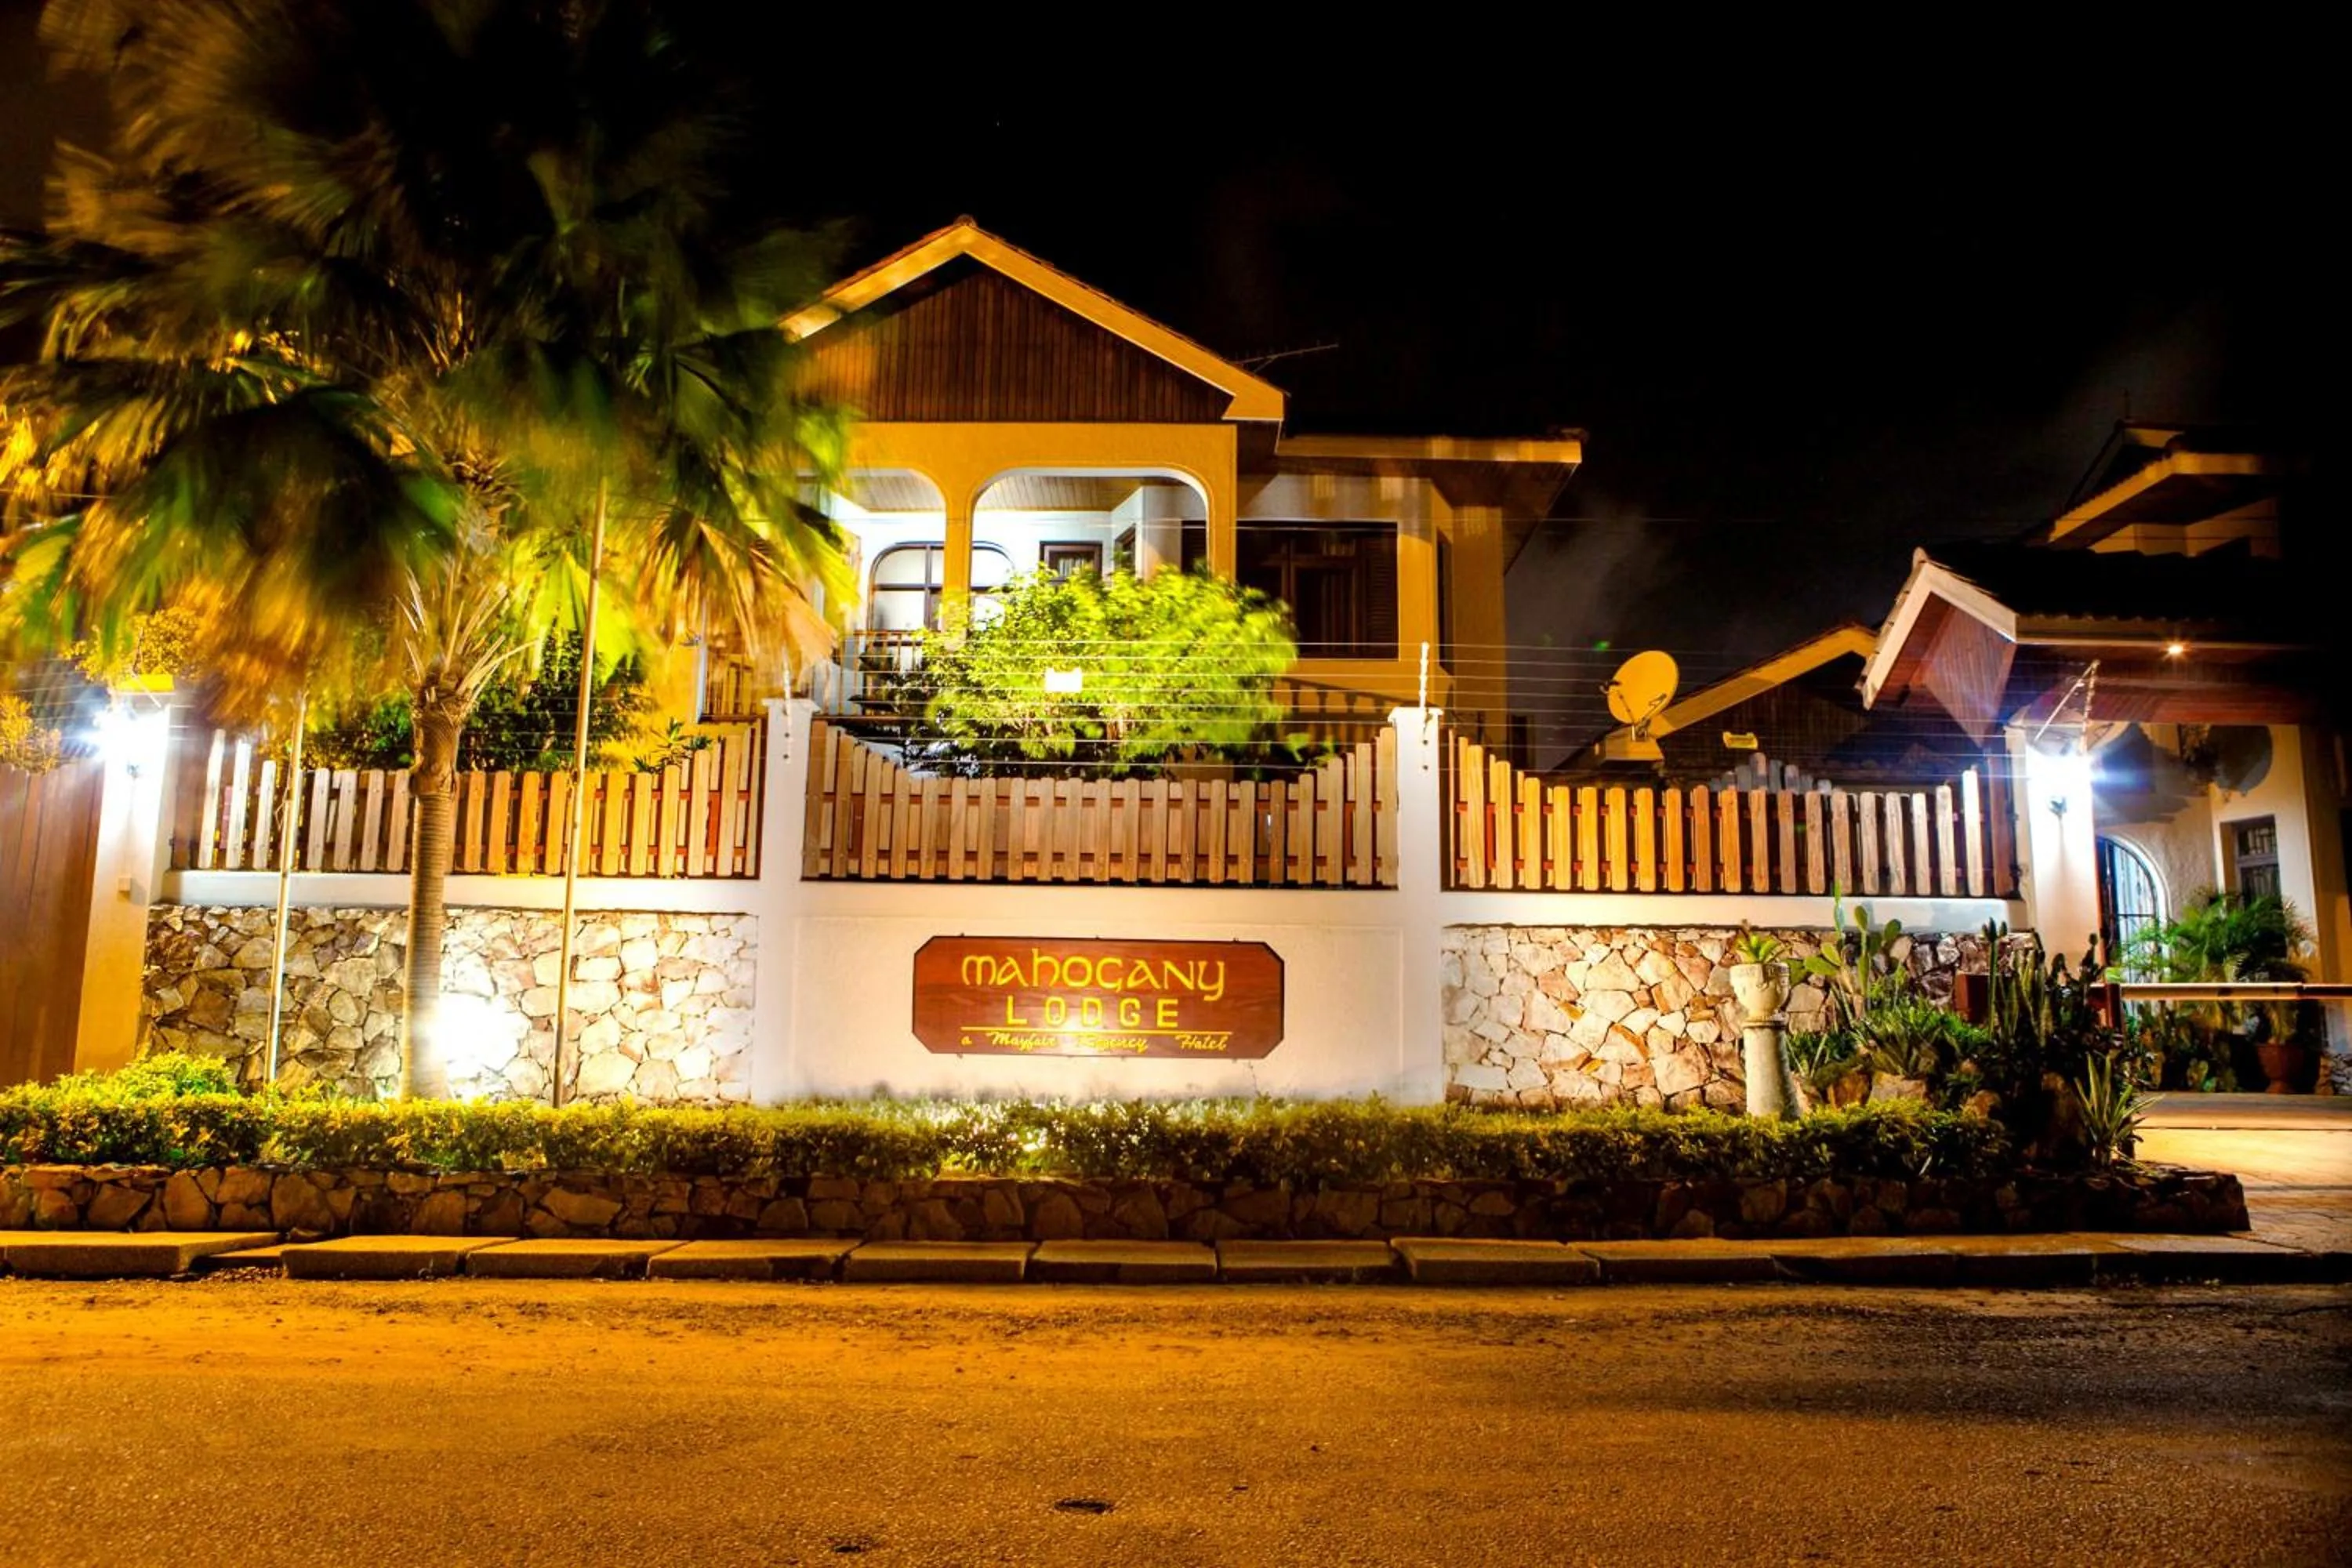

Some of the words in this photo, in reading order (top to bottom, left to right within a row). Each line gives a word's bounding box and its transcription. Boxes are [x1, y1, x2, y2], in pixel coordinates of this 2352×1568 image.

[1007, 995, 1178, 1028] LODGE
[960, 1036, 973, 1045] a
[985, 1031, 1056, 1051] Mayfair
[1077, 1033, 1148, 1053] Rency
